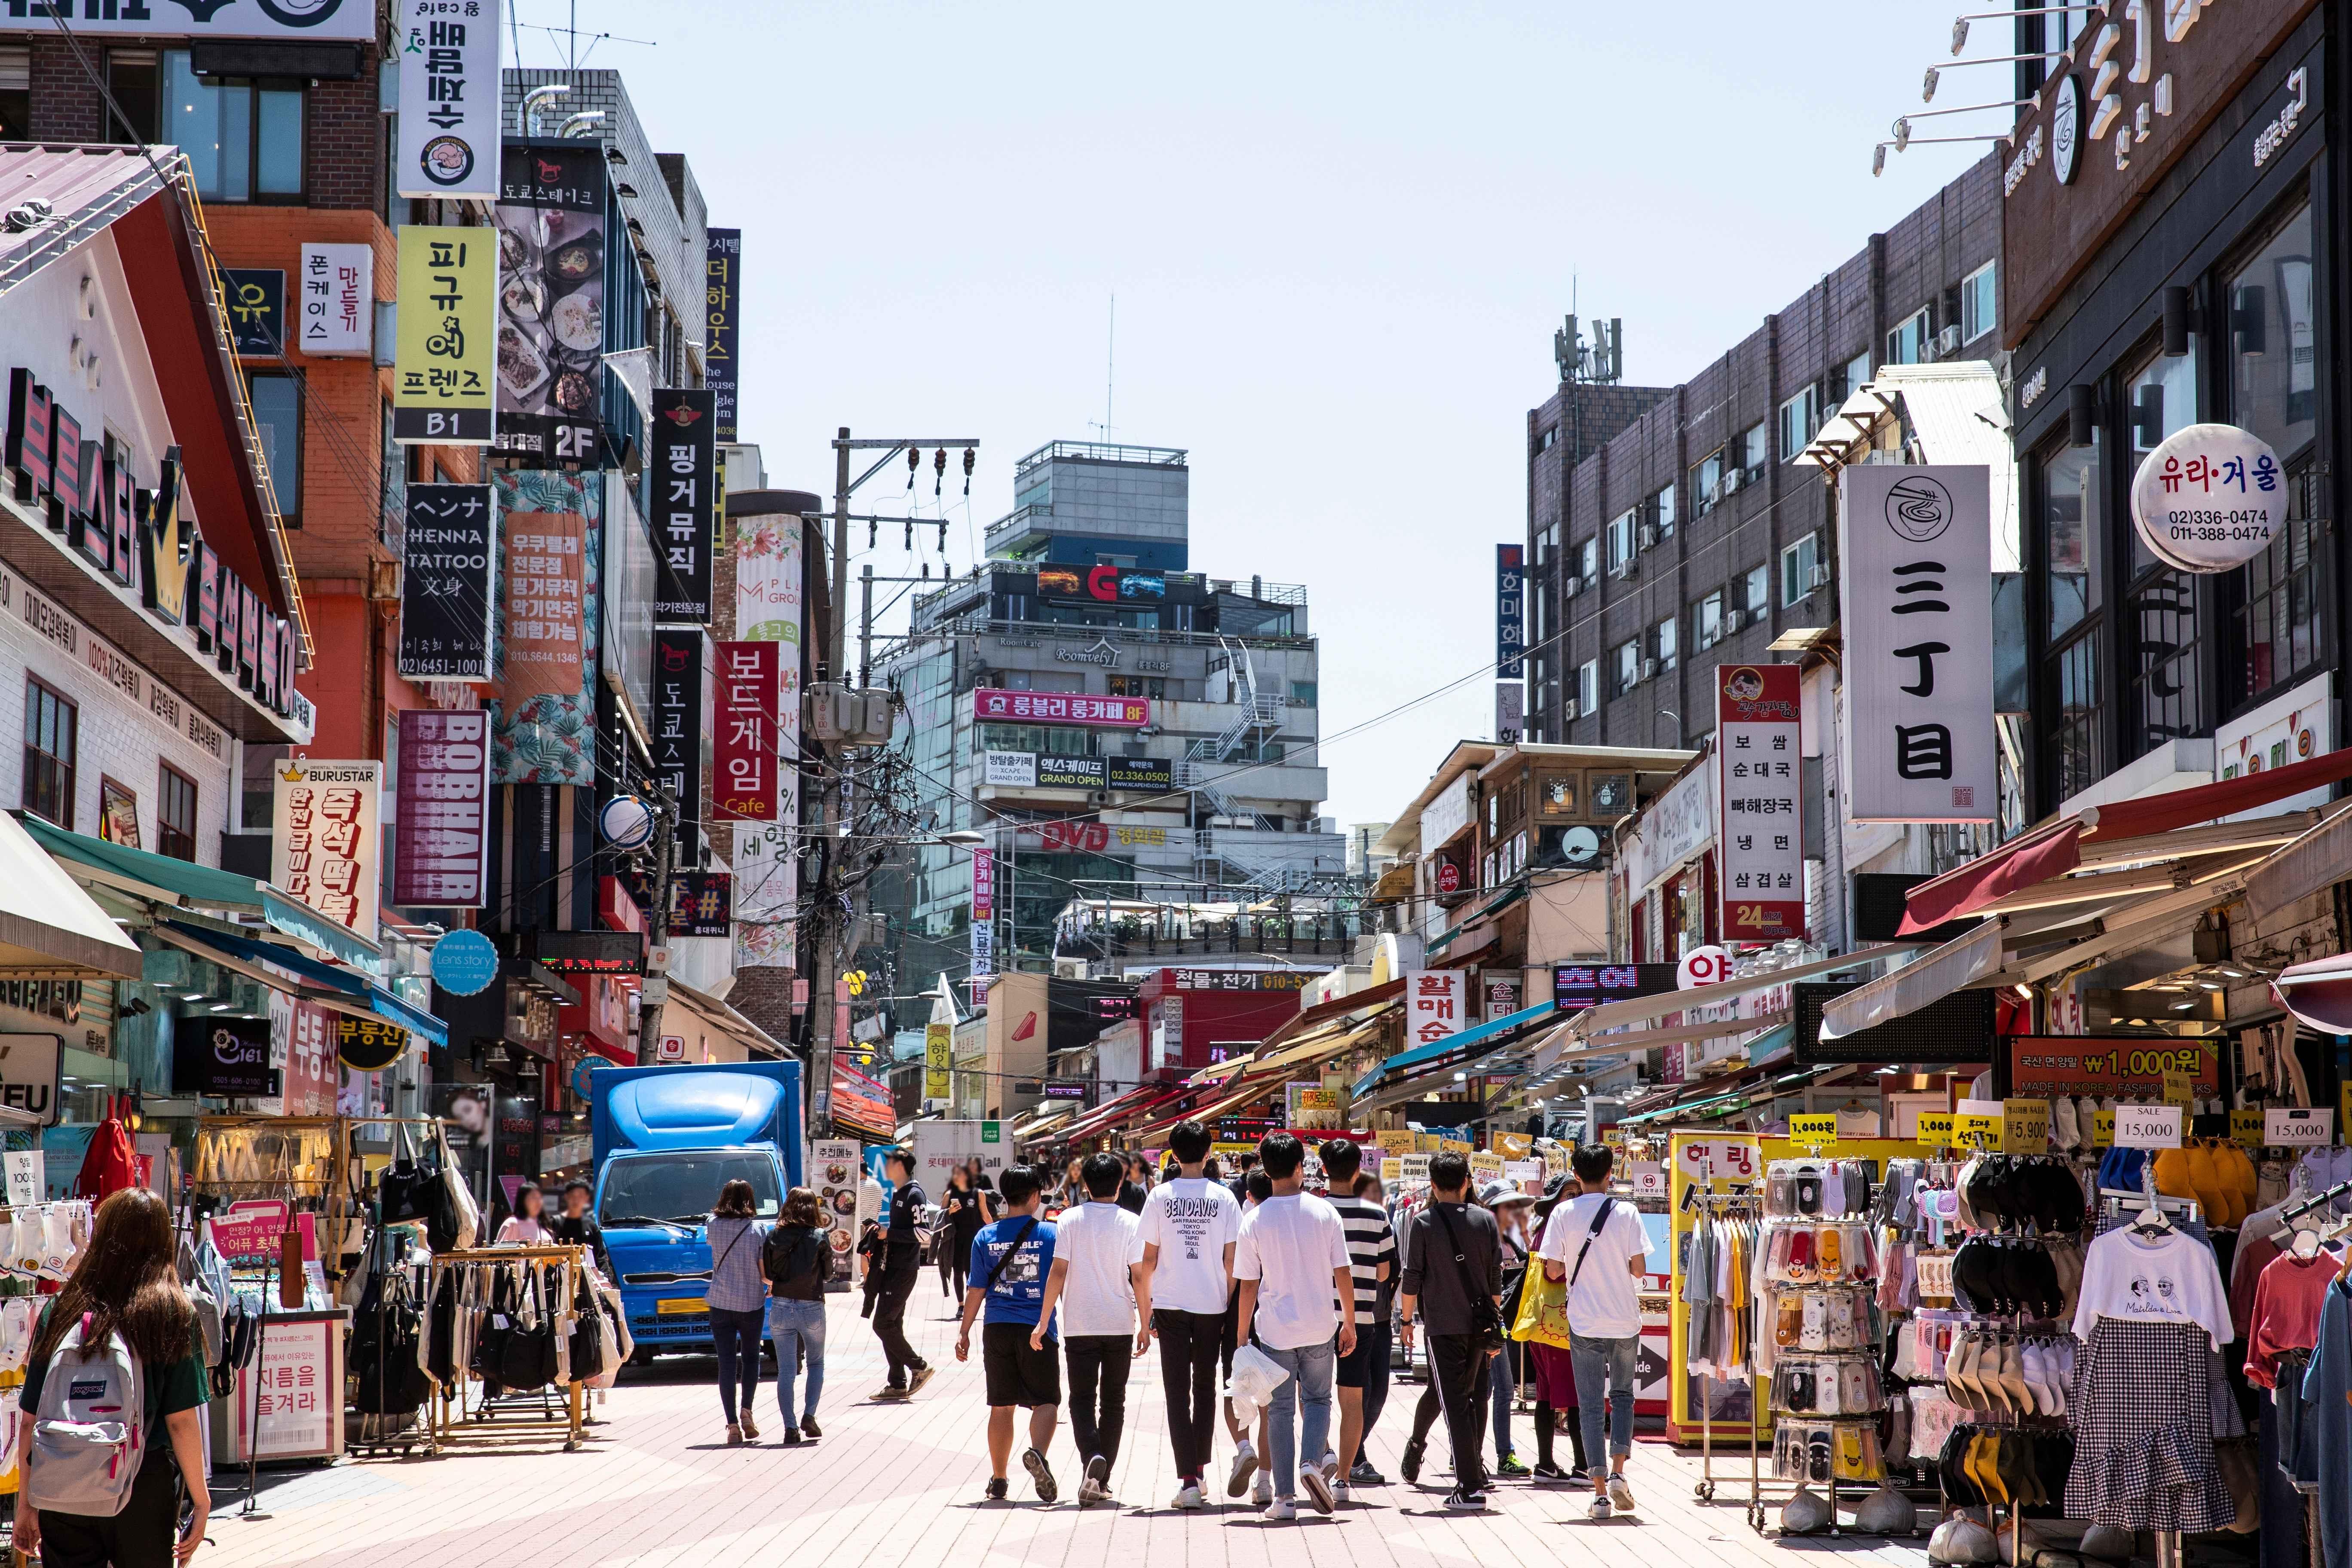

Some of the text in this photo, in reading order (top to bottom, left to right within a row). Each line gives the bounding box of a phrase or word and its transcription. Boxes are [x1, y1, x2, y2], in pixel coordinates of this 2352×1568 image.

[425, 21, 466, 129] 수제담배
[504, 185, 593, 204] 도쿄스테이크
[307, 255, 329, 339] 폰케이스
[339, 266, 359, 332] 만들기
[706, 258, 730, 359] 더하우스
[402, 368, 486, 397] 프렌즈
[427, 413, 459, 435] B1
[556, 425, 593, 457] 2F
[414, 497, 483, 518] ヘンナ
[668, 445, 696, 575] 핑거뮤직
[2169, 509, 2268, 527] 02)336-0474
[409, 529, 483, 543] HENNA
[2171, 525, 2270, 541] 011-388-0474
[512, 534, 579, 555] 우쿠렐레
[408, 554, 486, 569] TATTOO
[512, 557, 561, 575] 전문점
[420, 577, 464, 597] 文身
[512, 577, 578, 598] 핑거뮤직
[512, 599, 578, 617] 악기연주
[655, 602, 705, 614] 악기전문점
[511, 621, 577, 641] 체험가능
[1000, 638, 1041, 648] Room Cafe
[1056, 648, 1110, 666] Roomvely
[1160, 662, 1170, 671] 8F
[1891, 561, 1952, 781] 三丁目
[1013, 696, 1145, 720] 룸블리 룸카페 8F
[728, 650, 764, 792] 보드게임
[989, 754, 1032, 766] 방탈출카페
[1129, 761, 1153, 769] 예약문의
[309, 770, 374, 782] BURUSTAR
[1040, 774, 1104, 787] GRAND OPEN
[1111, 771, 1169, 782] 02.336.0502
[445, 714, 483, 900] BOBHAIR
[725, 798, 765, 813] Cafe
[1042, 821, 1109, 853] DVD
[1116, 827, 1165, 846] 영화관
[321, 787, 362, 928] 즉석떡볶
[976, 910, 989, 918] 8F
[1737, 905, 1762, 929] 24
[1762, 911, 1782, 922] 시간
[695, 926, 725, 934] 홍대퀴니
[1763, 925, 1792, 936] Open
[437, 954, 491, 967] Lens story
[339, 1020, 402, 1046] 부동산
[295, 1008, 337, 1084] 부동산
[931, 1043, 946, 1078] 향수
[2021, 1056, 2043, 1068] 국산
[2046, 1056, 2056, 1067] 면
[2058, 1056, 2078, 1068] 양말
[2022, 1081, 2165, 1094] MADE IN KOREA FASHION
[2137, 1107, 2160, 1115] SALE
[1792, 1121, 1835, 1136] 1,000원
[1968, 1119, 1991, 1128] 휴대용
[2125, 1123, 2173, 1138] 15,000
[2275, 1124, 2324, 1138] 15,000
[1440, 1133, 1467, 1142] ATM
[819, 1148, 853, 1157] 추천메뉴
[1477, 1170, 1498, 1178] SALE
[911, 1204, 929, 1225] 32
[1164, 1197, 1218, 1218] BEN DAVIS
[228, 1225, 250, 1236] 인정?
[2125, 1302, 2159, 1315] Matilda
[287, 1352, 315, 1360] 이유있는
[256, 1366, 316, 1389] 지름을
[258, 1391, 316, 1415] 즐겨라
